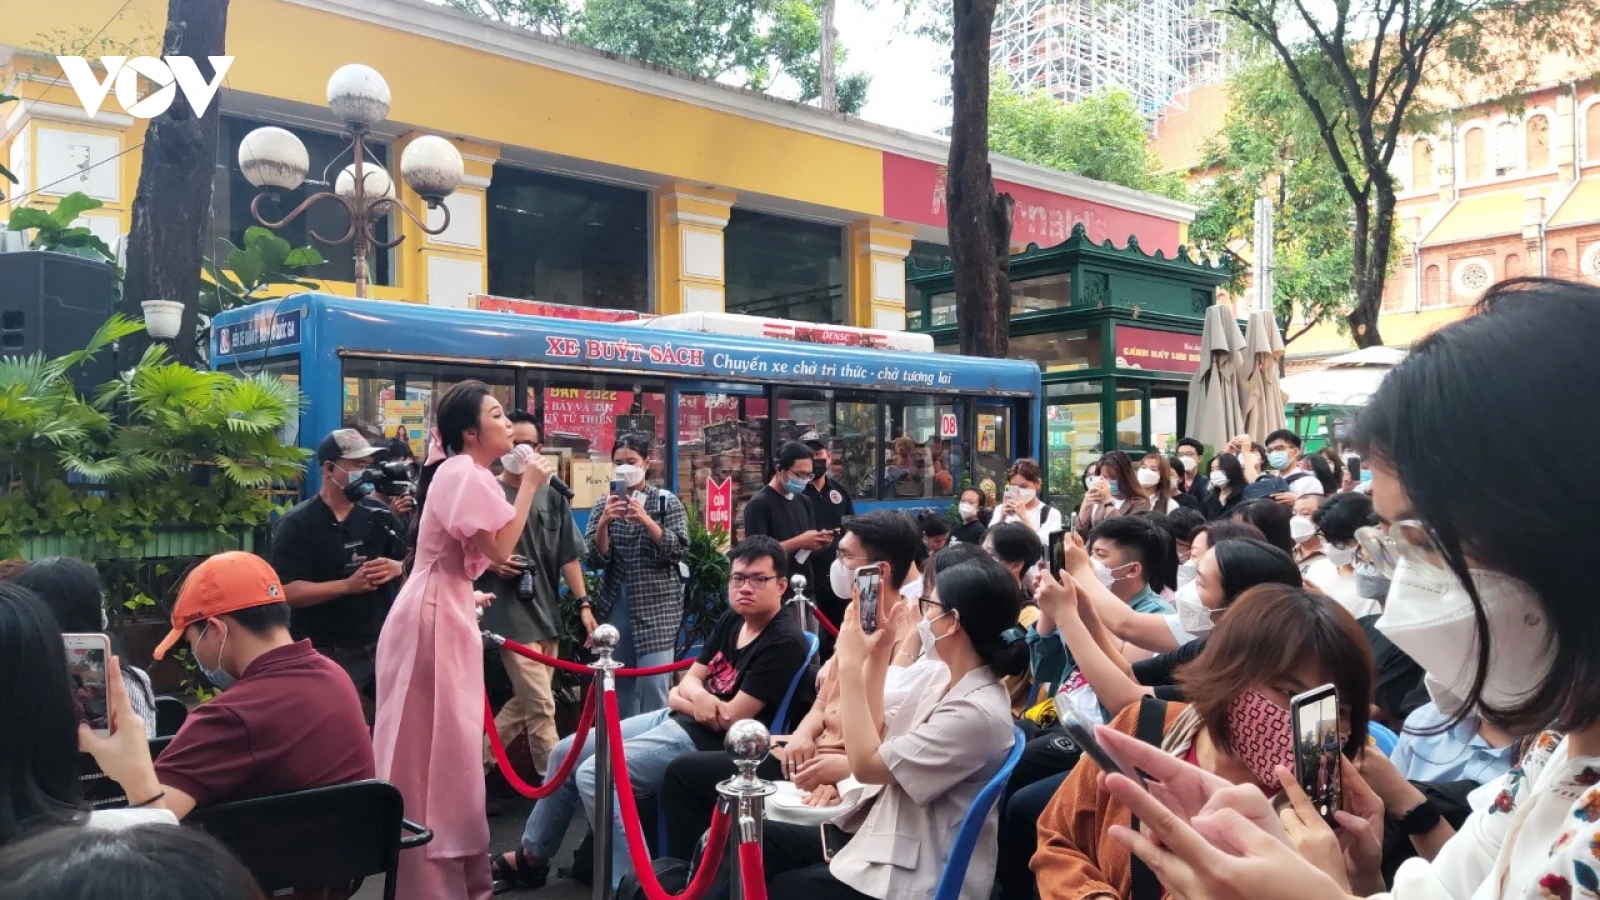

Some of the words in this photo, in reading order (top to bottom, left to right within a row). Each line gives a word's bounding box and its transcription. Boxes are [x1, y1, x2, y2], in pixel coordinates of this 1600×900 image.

[545, 336, 580, 356] XE
[585, 337, 644, 361] BUÝT
[650, 341, 705, 366] SÁCH
[713, 353, 767, 375] Chuyến
[771, 361, 788, 373] xe
[793, 359, 817, 375] chở
[821, 363, 836, 377] tri
[840, 364, 867, 379] thức
[877, 367, 899, 381] chở
[903, 370, 935, 386] tương
[938, 371, 952, 384] lai
[584, 390, 617, 400] 2022
[942, 415, 956, 434] 08
